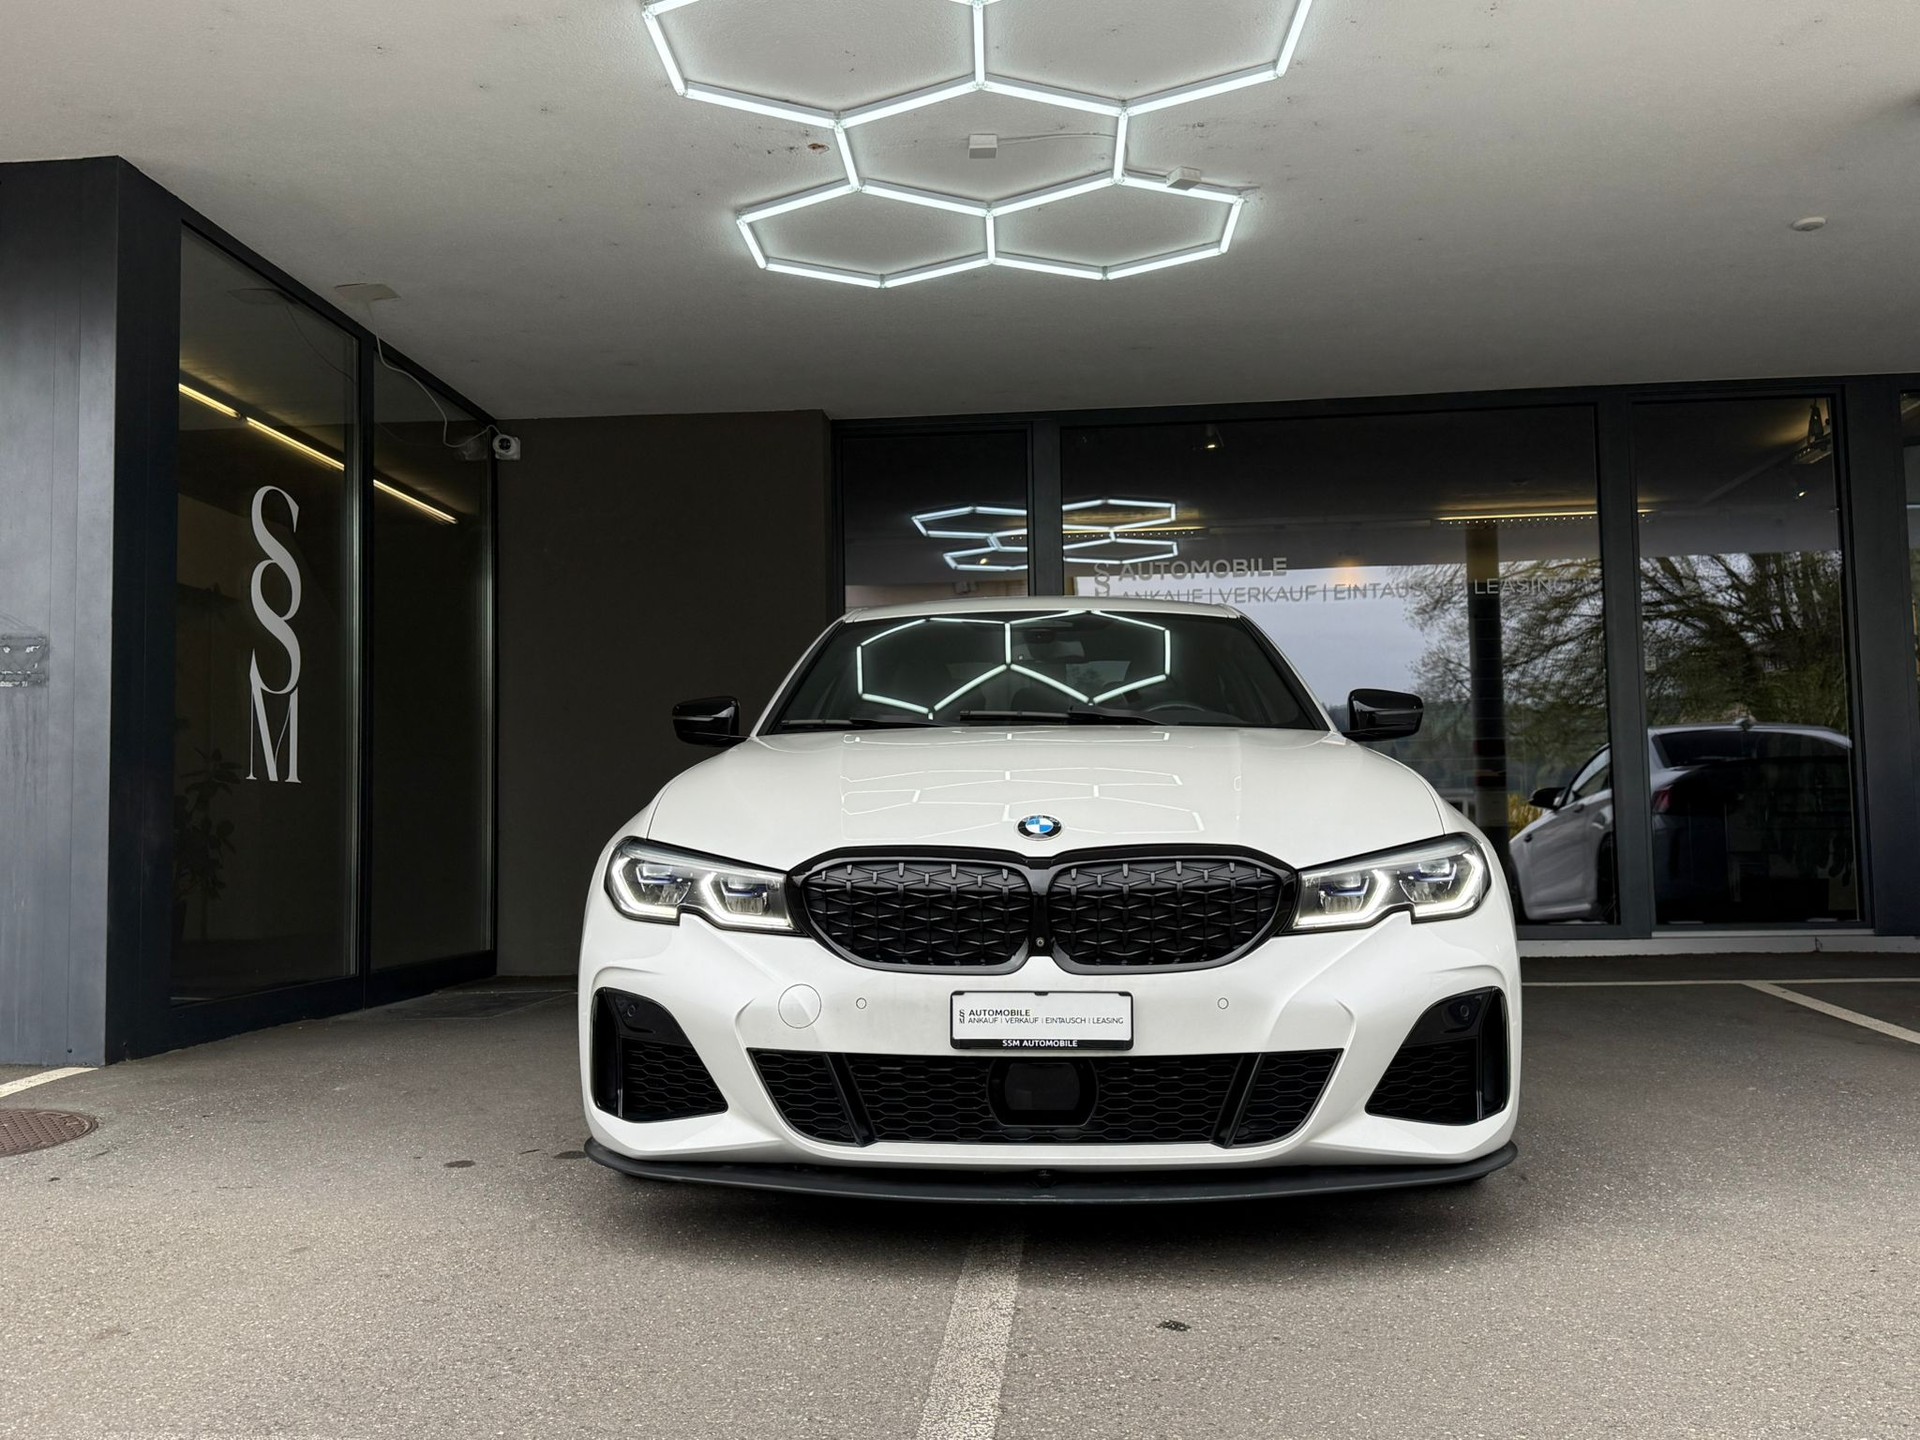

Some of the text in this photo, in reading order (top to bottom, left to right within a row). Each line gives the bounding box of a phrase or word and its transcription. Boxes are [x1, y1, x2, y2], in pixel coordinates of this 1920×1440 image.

[1118, 558, 1288, 581] AUTOMOBILE
[1218, 585, 1317, 604] VERKAUF
[1474, 576, 1569, 595] LEASING
[968, 1009, 1031, 1017] AUTOMOBILE
